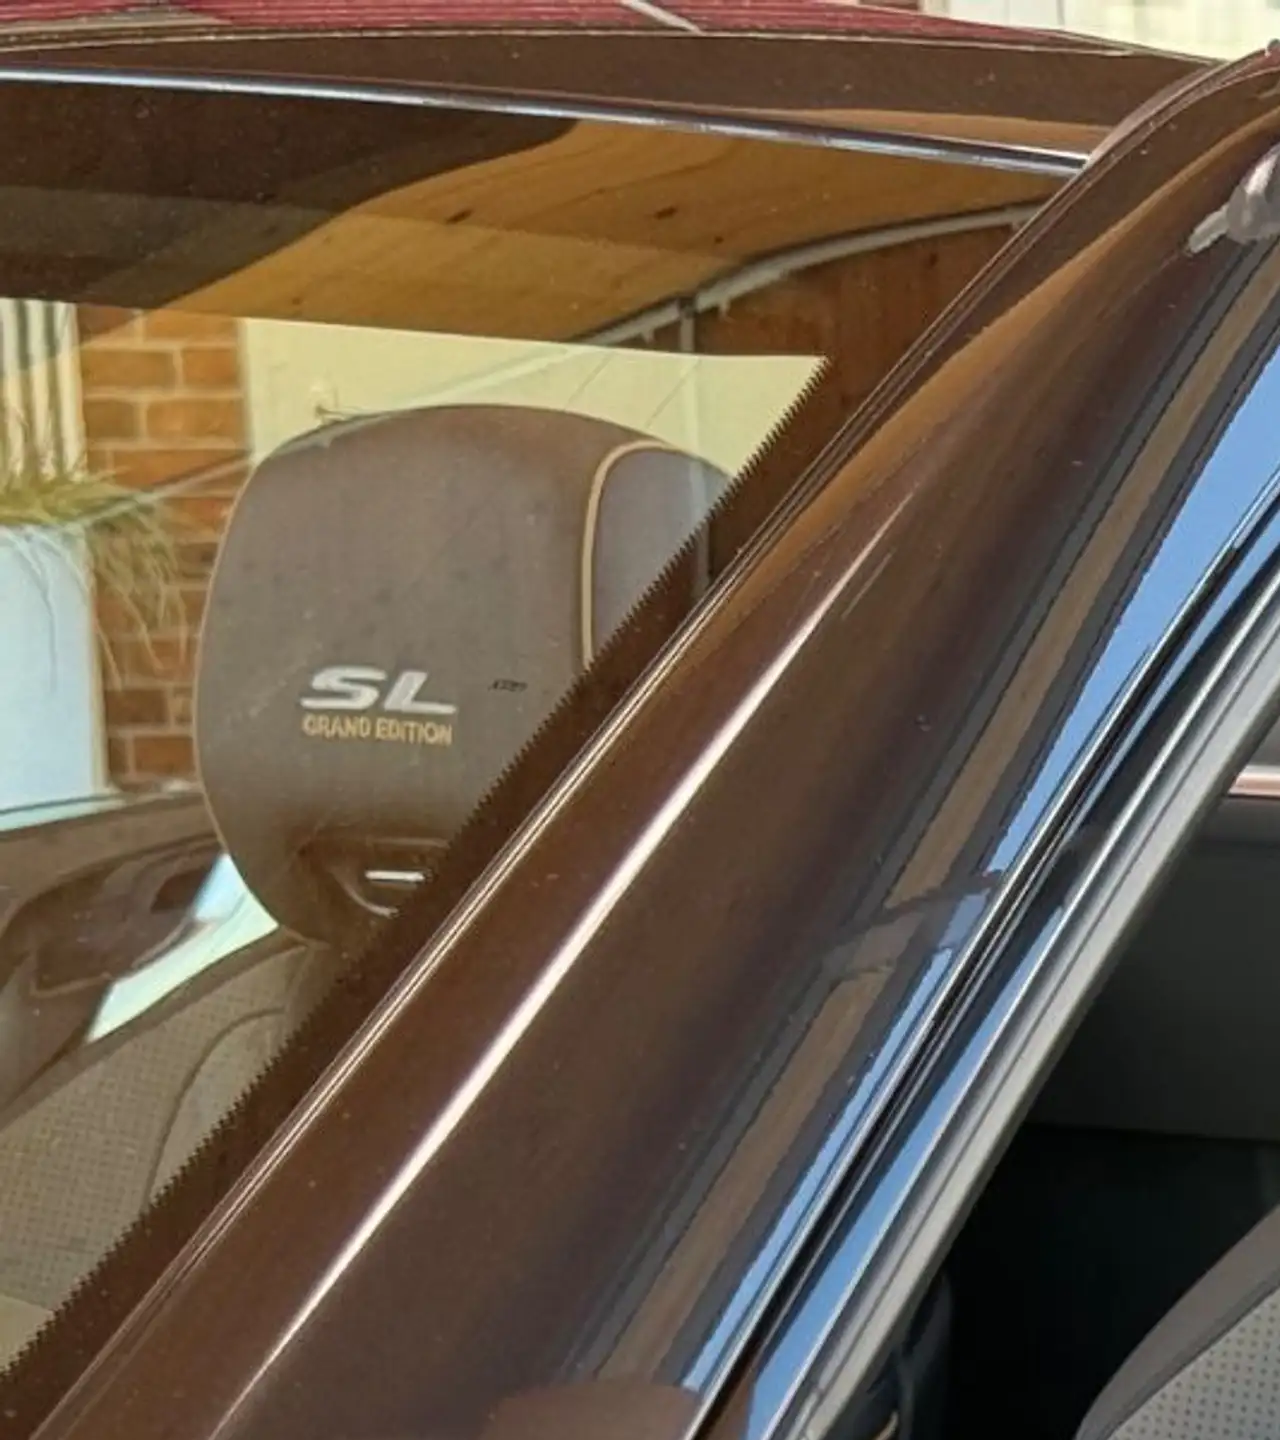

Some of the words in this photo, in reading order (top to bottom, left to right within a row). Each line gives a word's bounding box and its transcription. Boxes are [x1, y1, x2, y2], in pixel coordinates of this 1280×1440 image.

[300, 665, 457, 714] SL
[302, 713, 371, 738] GRAND
[375, 717, 453, 745] EDITION
